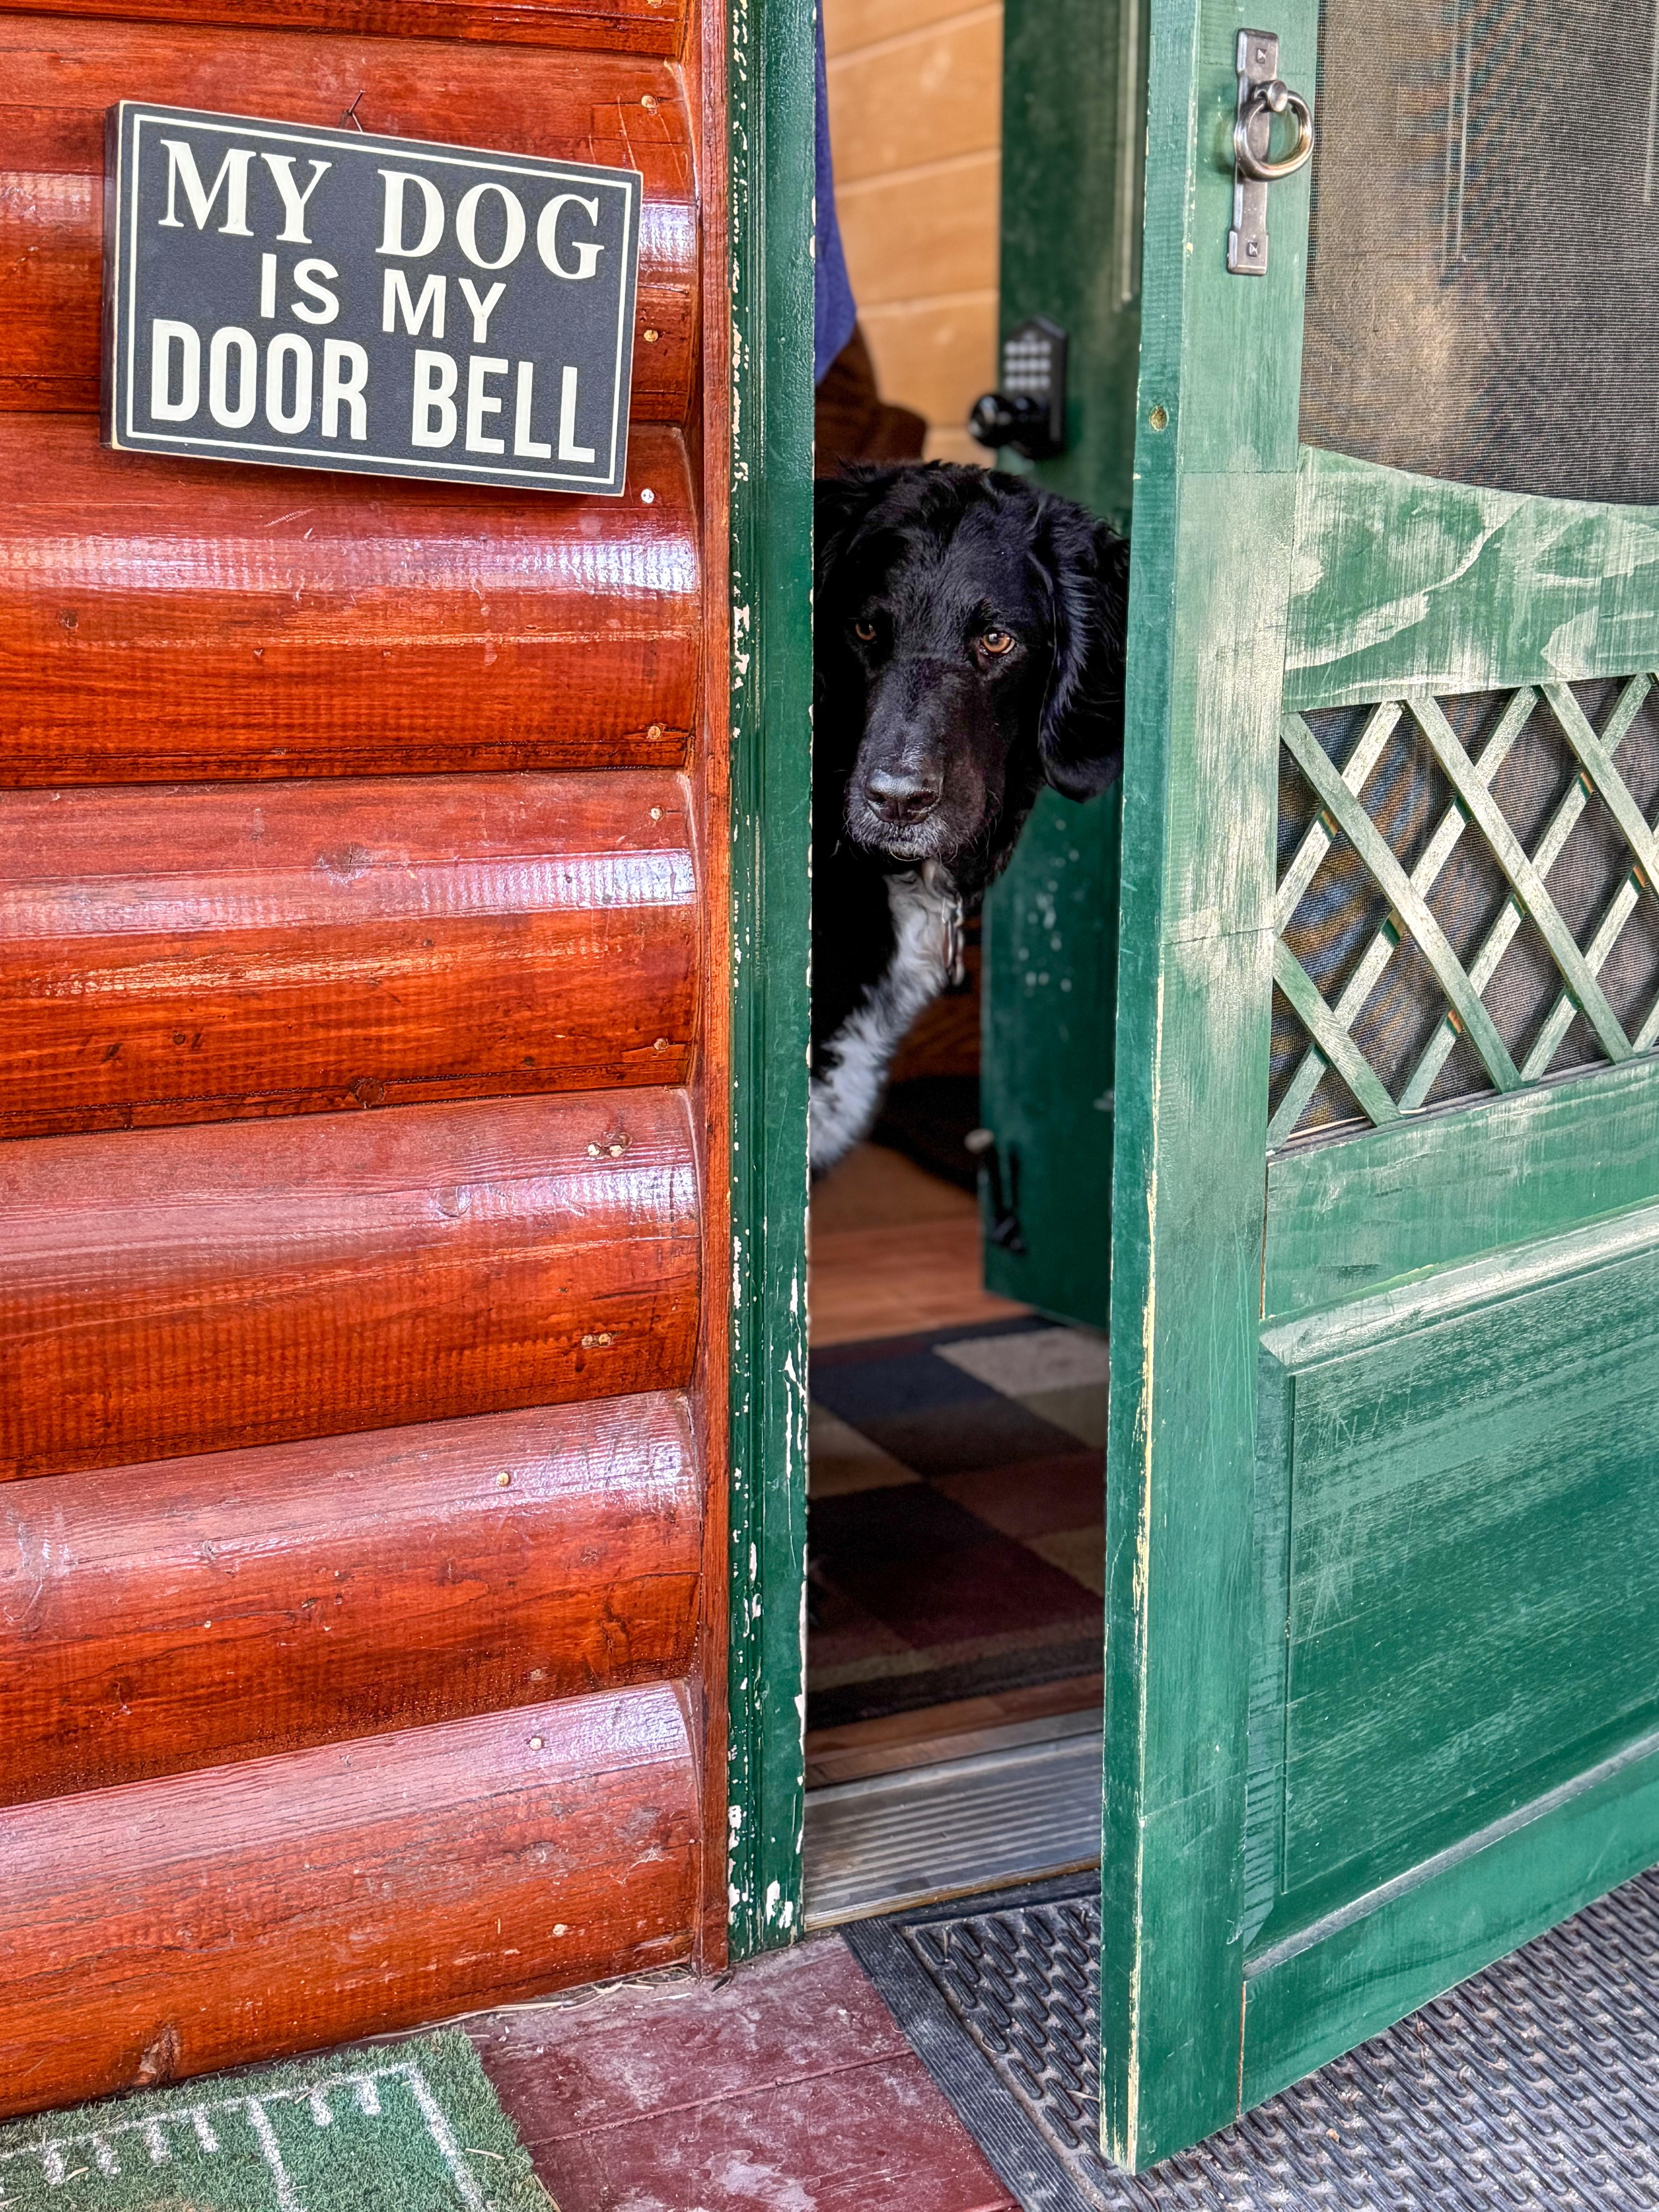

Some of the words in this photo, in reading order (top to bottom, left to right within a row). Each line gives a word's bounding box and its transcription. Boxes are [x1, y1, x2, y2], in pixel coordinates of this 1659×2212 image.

[158, 139, 333, 244] MY
[375, 168, 605, 280] DOG
[260, 252, 340, 325] IS
[382, 268, 507, 344] MY
[150, 318, 369, 441] DOOR
[411, 349, 596, 464] BELL
